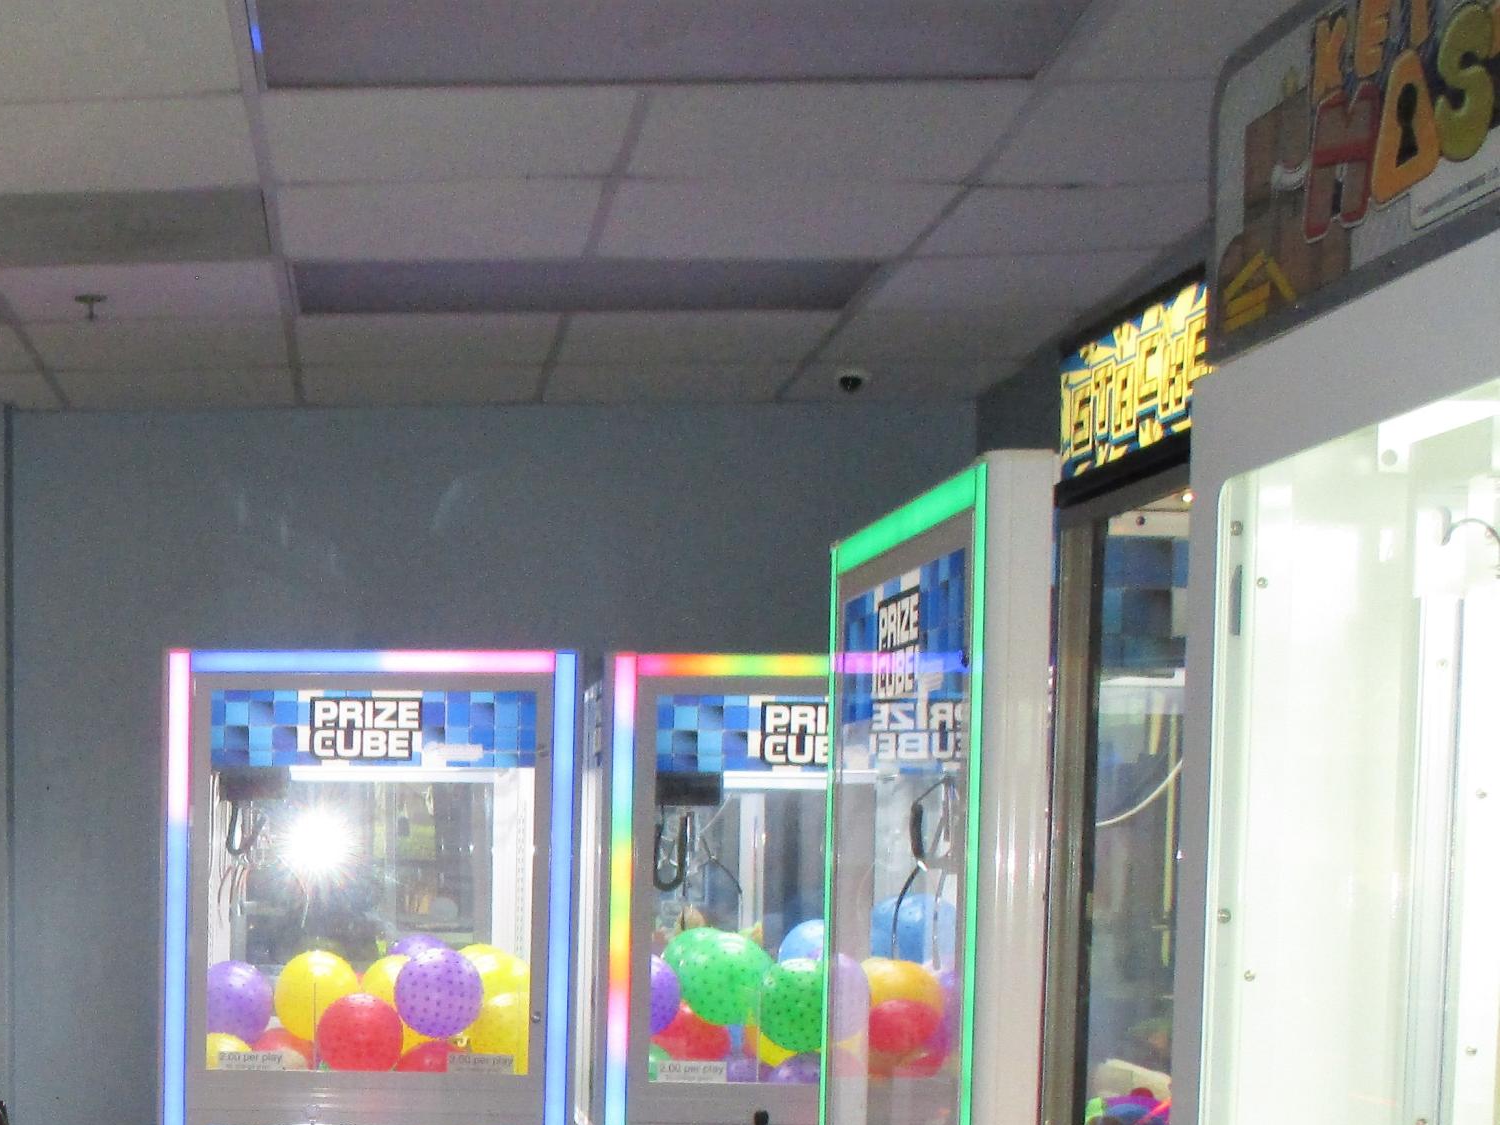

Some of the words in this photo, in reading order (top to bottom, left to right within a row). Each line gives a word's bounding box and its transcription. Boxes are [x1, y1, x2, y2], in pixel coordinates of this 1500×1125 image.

[1310, 0, 1430, 105] KE
[1303, 0, 1500, 243] HOS
[879, 592, 919, 651] PRIZE
[313, 700, 420, 729] PRIZE
